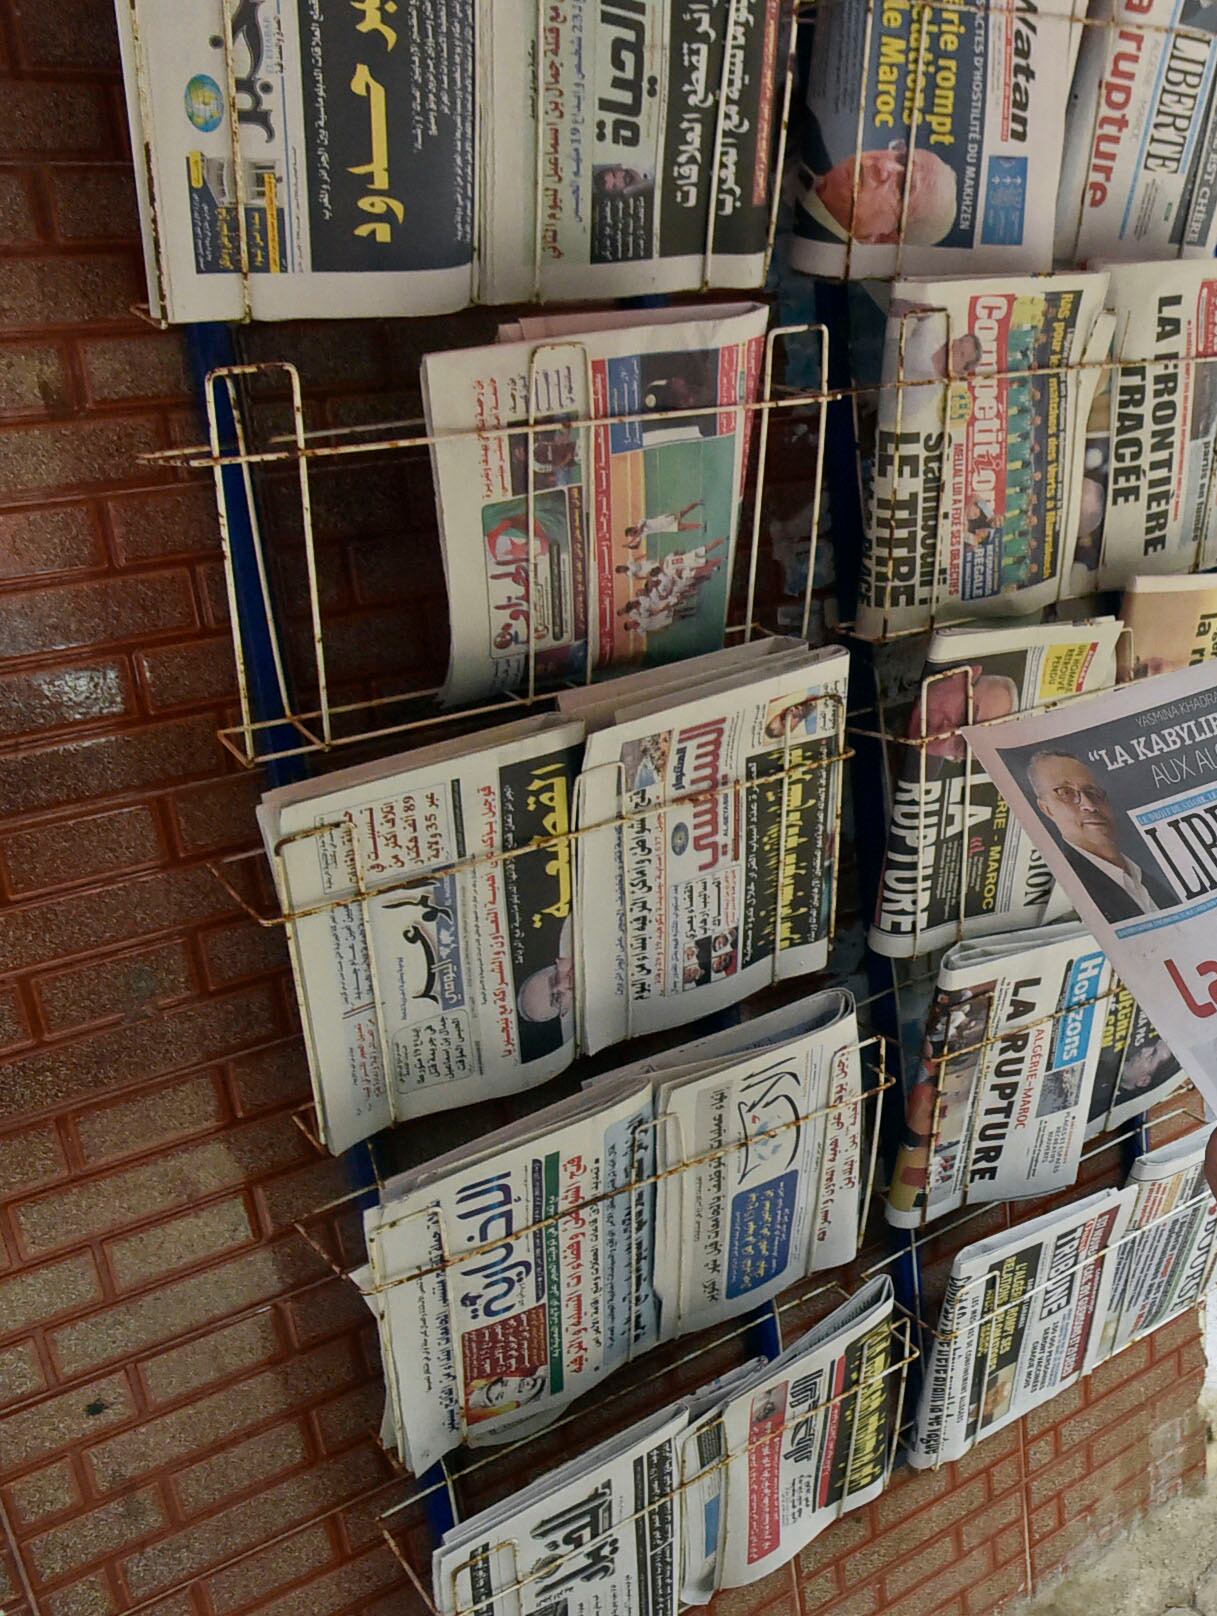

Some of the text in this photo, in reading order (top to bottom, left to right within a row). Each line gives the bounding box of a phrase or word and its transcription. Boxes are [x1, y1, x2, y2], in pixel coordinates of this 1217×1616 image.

[569, 14, 585, 144] 23 شخص 19
[869, 34, 907, 130] Maroc
[923, 57, 964, 146] rompt
[311, 22, 331, 220] العلاقات الدبلوماسية بين الجزائر والمغرب
[544, 5, 566, 259] مع قتلة جمال بن اسماعيل لليوم الثاني
[671, 40, 717, 207] تقطع العلاقات
[720, 103, 750, 133] مع
[957, 56, 990, 230] D'HOSTILITÉ DU MAKHZEN
[1079, 28, 1147, 206] rupture
[341, 61, 406, 244] حدود
[1185, 184, 1214, 244] CHÈRE
[1046, 436, 1058, 460] des
[1108, 357, 1156, 508] TRACÉE
[1136, 293, 1186, 558] LA FRONTIÈRE
[950, 481, 962, 495] LUI
[951, 443, 963, 480] MELLAL
[871, 431, 921, 609] LE TITRE
[949, 529, 961, 546] SES
[946, 548, 961, 596] OBJECTIFS
[1195, 609, 1217, 640] la
[1048, 655, 1062, 684] PENDU
[1064, 658, 1080, 692] HOMME
[1135, 705, 1179, 730] YASMINA
[628, 784, 651, 811] فتح
[1149, 752, 1196, 789] AUX
[401, 794, 416, 813] 89
[424, 790, 444, 860] عبر 35 ولاية
[944, 772, 996, 838] LA
[366, 862, 386, 874] في
[387, 853, 404, 869] من
[404, 834, 424, 866] هكتار
[877, 780, 943, 931] RUPTURE
[981, 845, 1001, 910] MAROC
[629, 893, 651, 929] الترفيه
[631, 959, 651, 980] من
[439, 1014, 449, 1036] جمال
[497, 1001, 513, 1016] مع
[967, 976, 1042, 1185] LA RUPTURE
[703, 1110, 727, 1277] عمليات بالجامعات قبل شهر
[560, 1150, 588, 1378] فتح وفضاءات التسلية والترفيه
